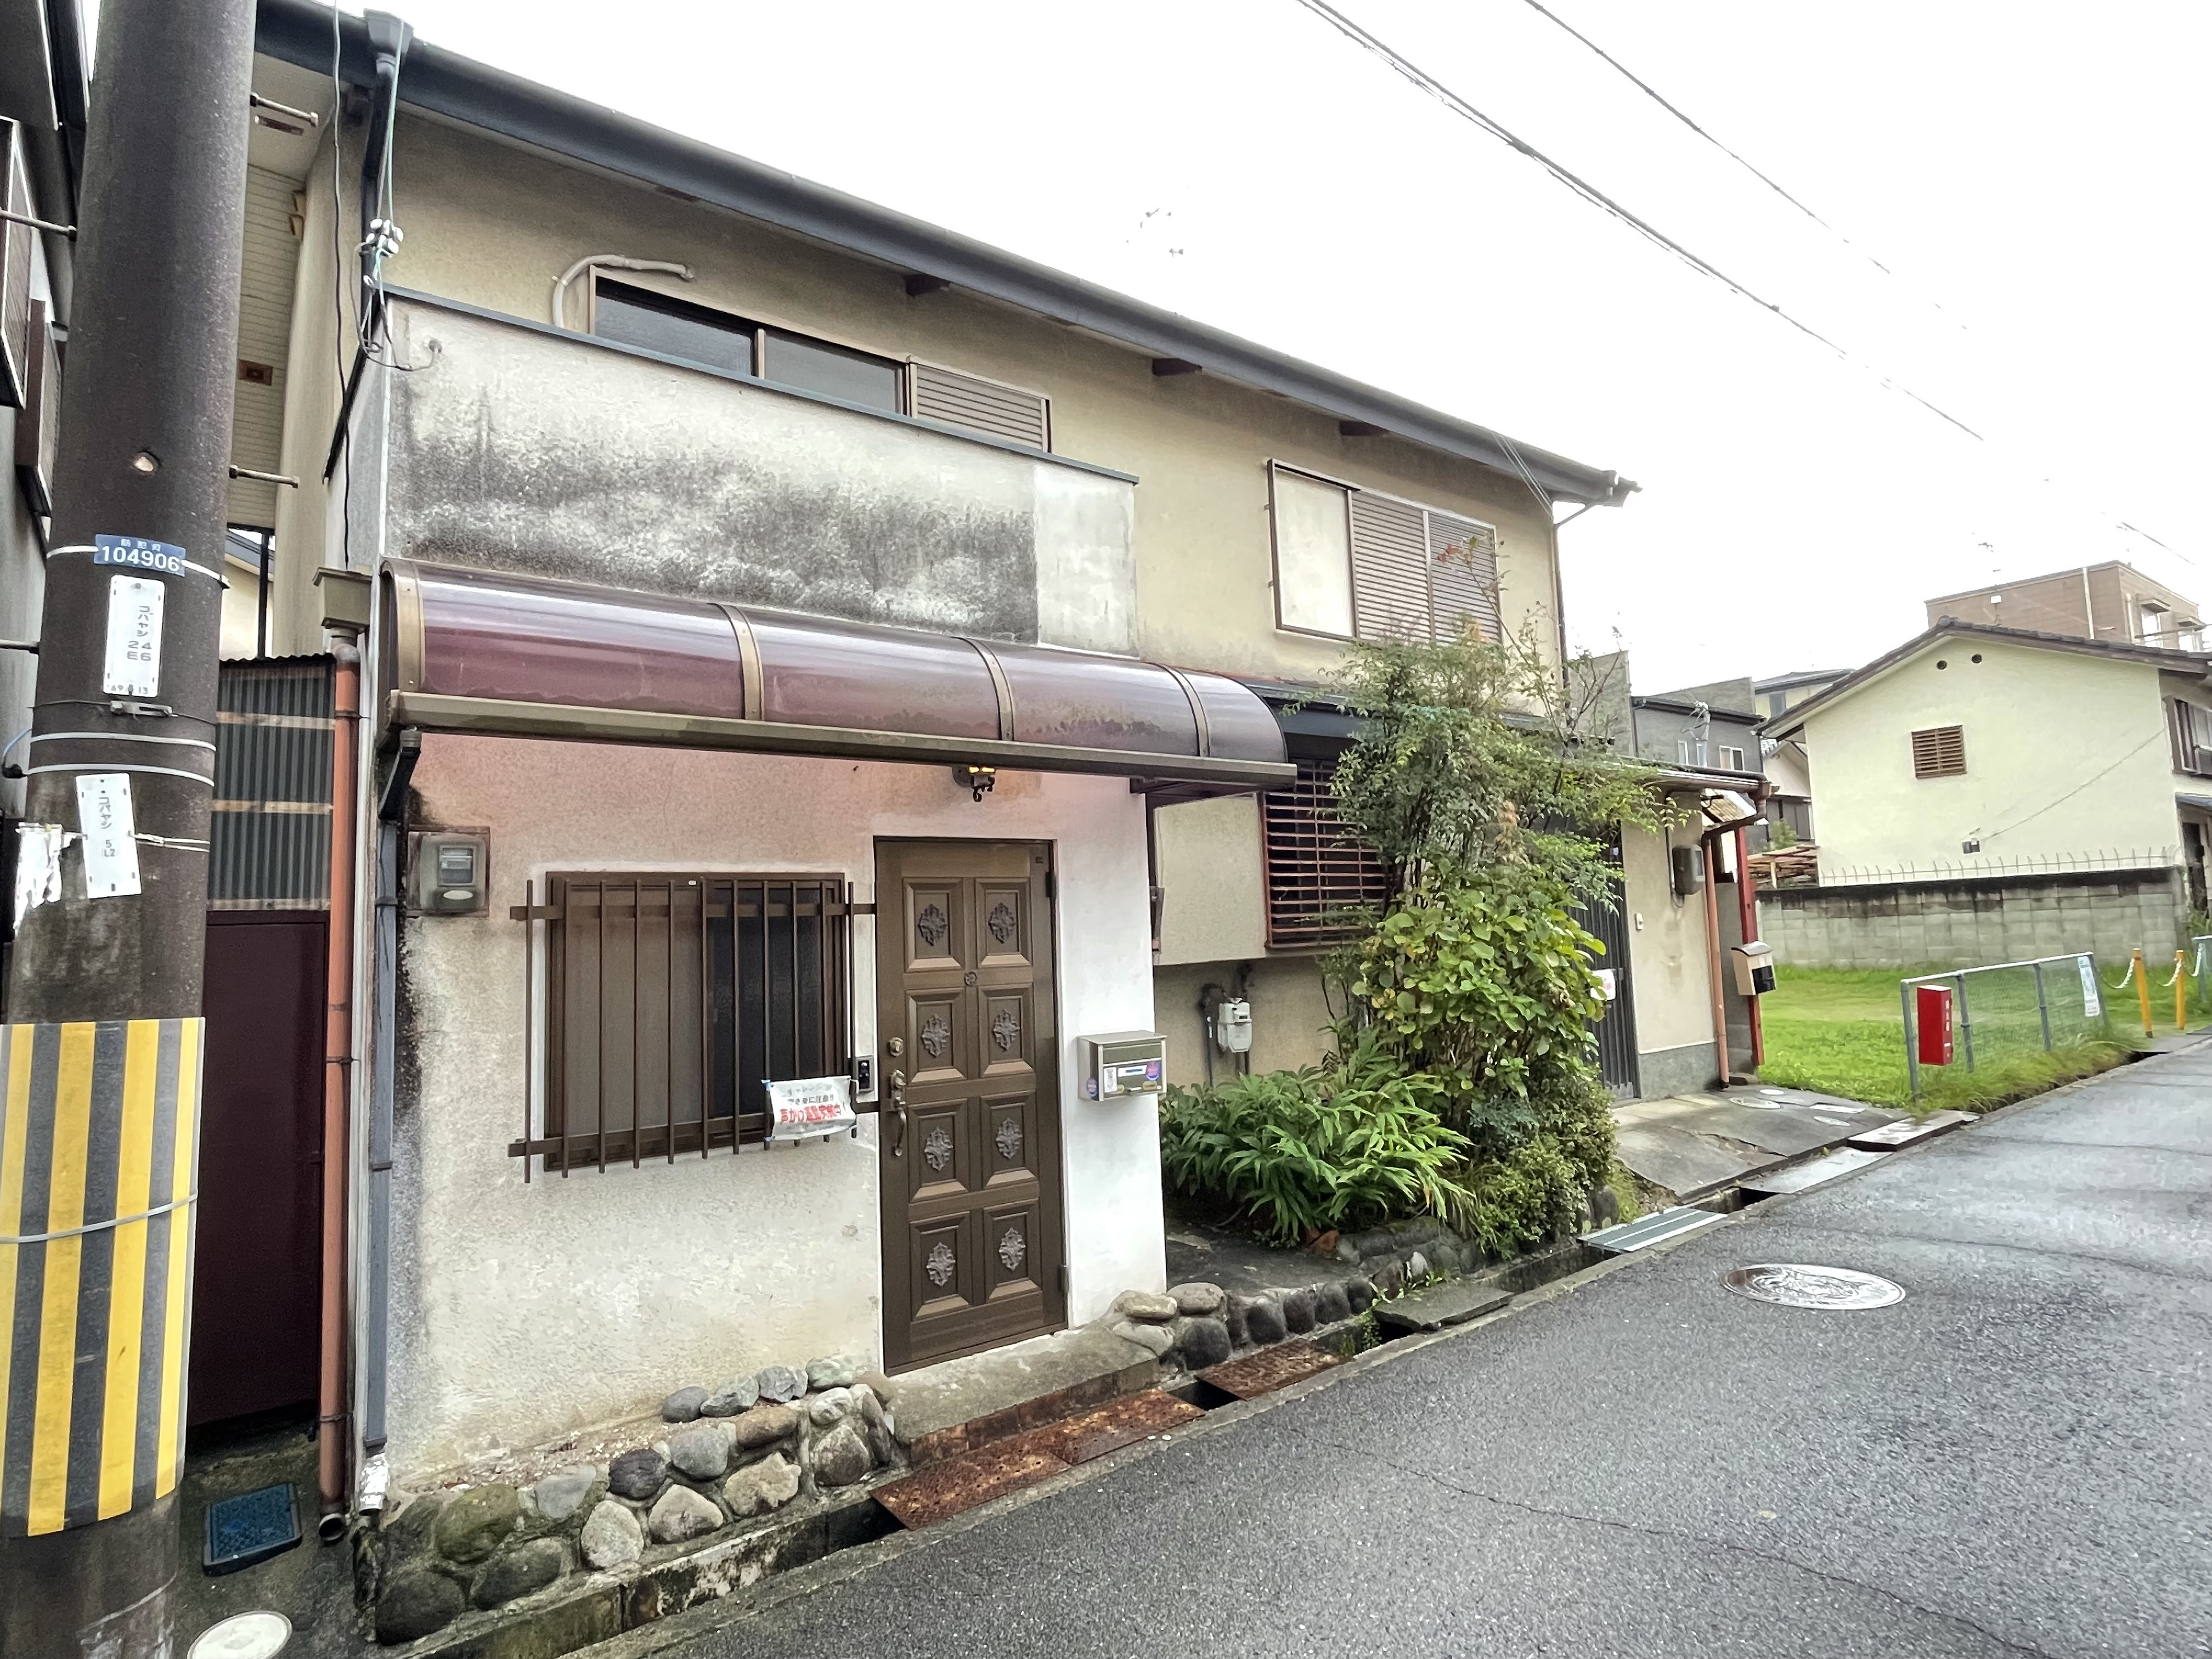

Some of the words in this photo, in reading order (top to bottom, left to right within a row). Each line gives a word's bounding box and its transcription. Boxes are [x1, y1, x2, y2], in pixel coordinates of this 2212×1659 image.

[102, 545, 180, 572] 104906
[127, 640, 152, 650] 24
[105, 839, 112, 848] 5
